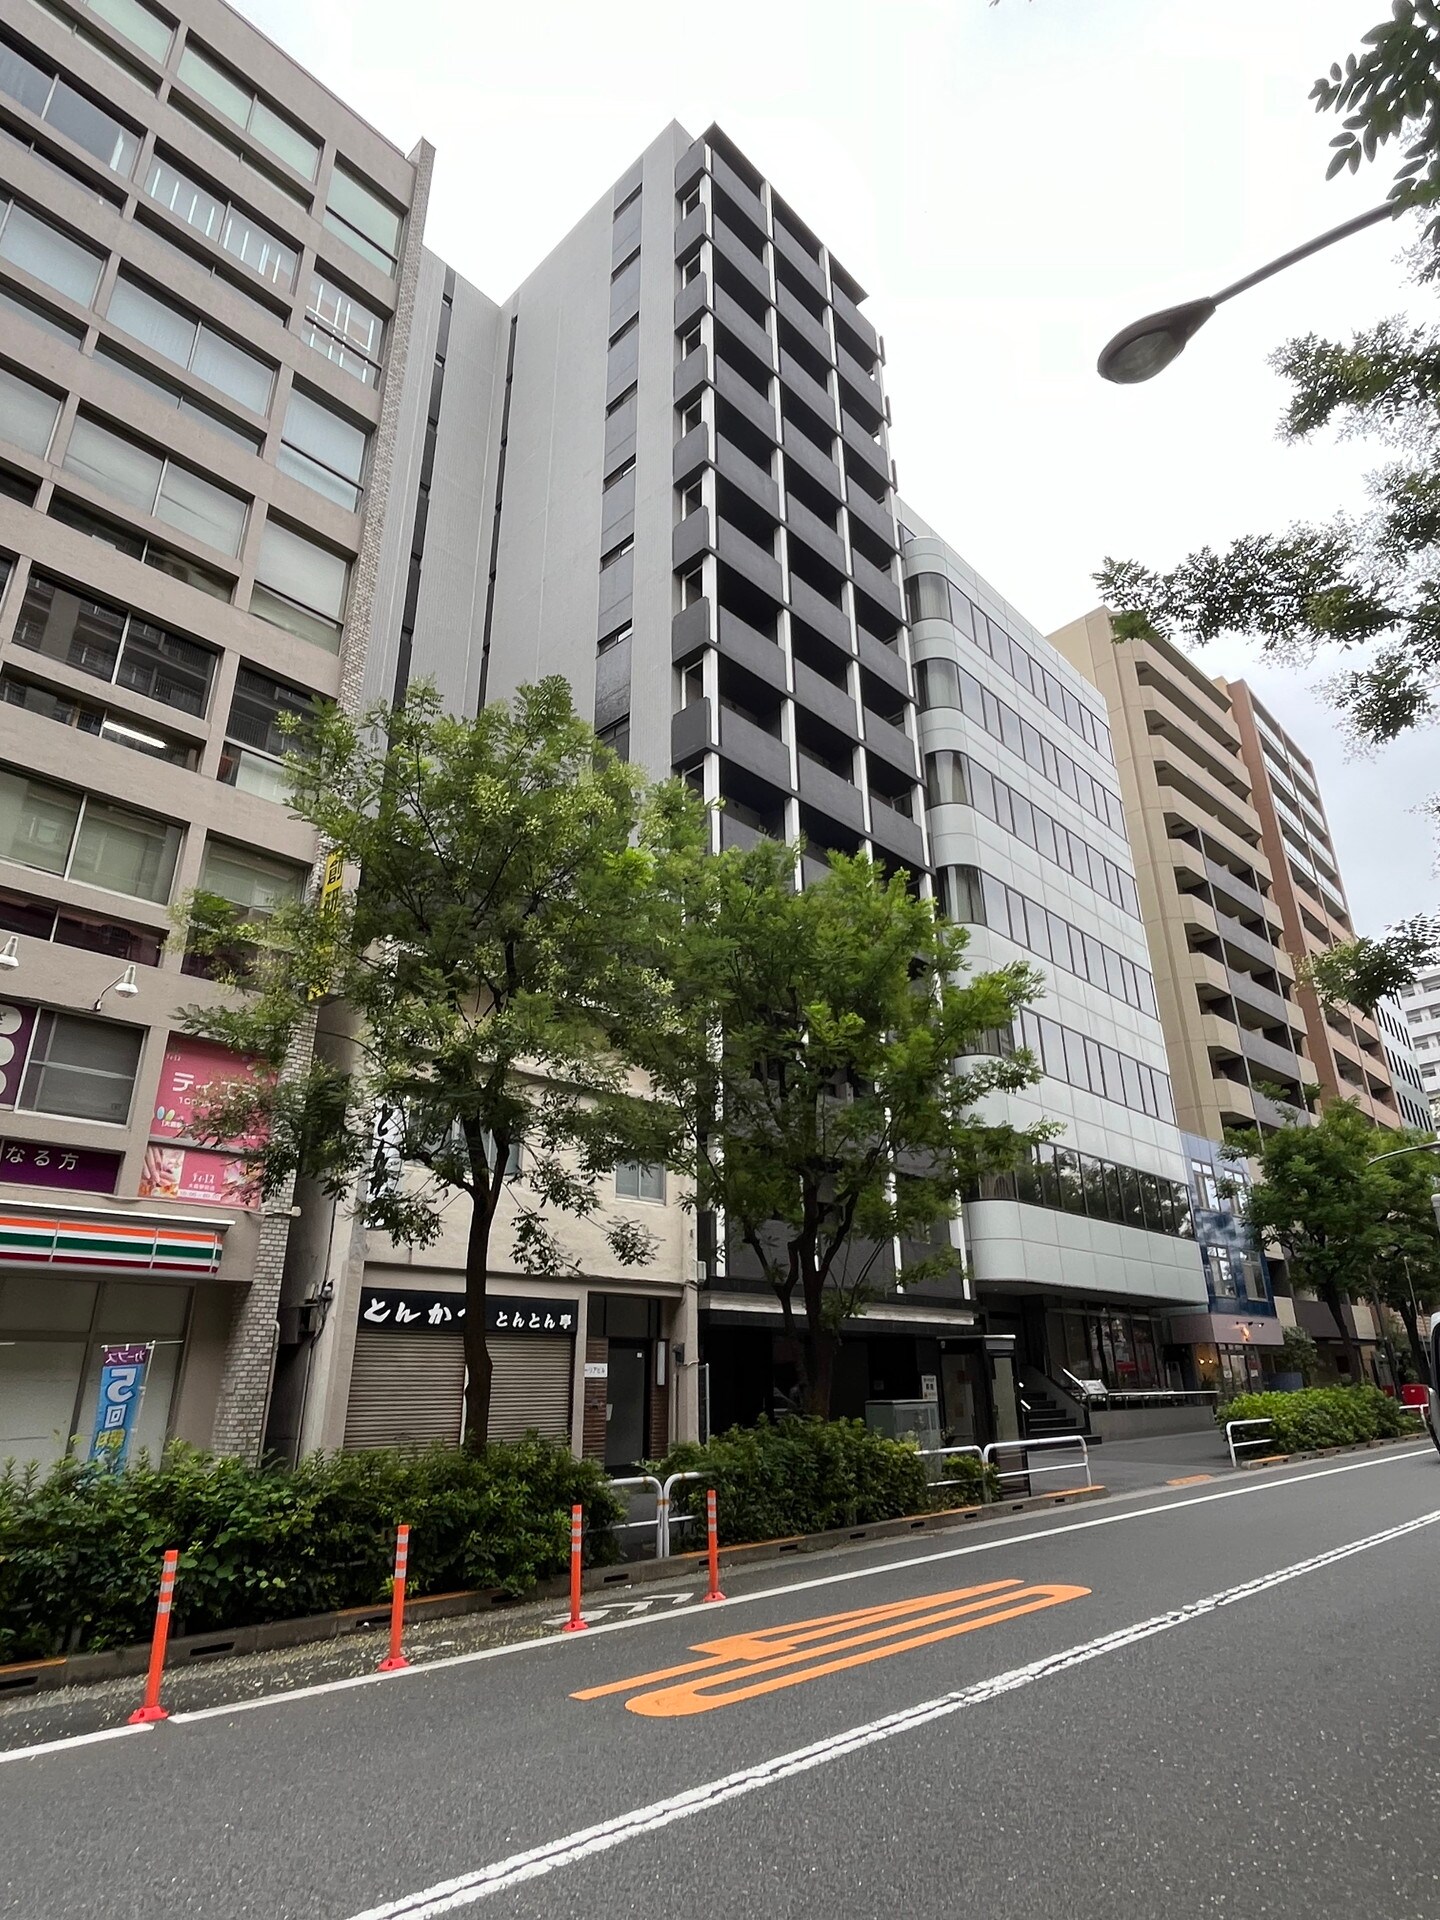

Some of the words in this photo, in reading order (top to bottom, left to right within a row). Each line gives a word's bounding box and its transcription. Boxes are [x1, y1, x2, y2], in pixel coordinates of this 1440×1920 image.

[5, 1146, 79, 1171] なる方
[363, 1297, 467, 1325] とんか
[495, 1311, 572, 1330] とんとん亭
